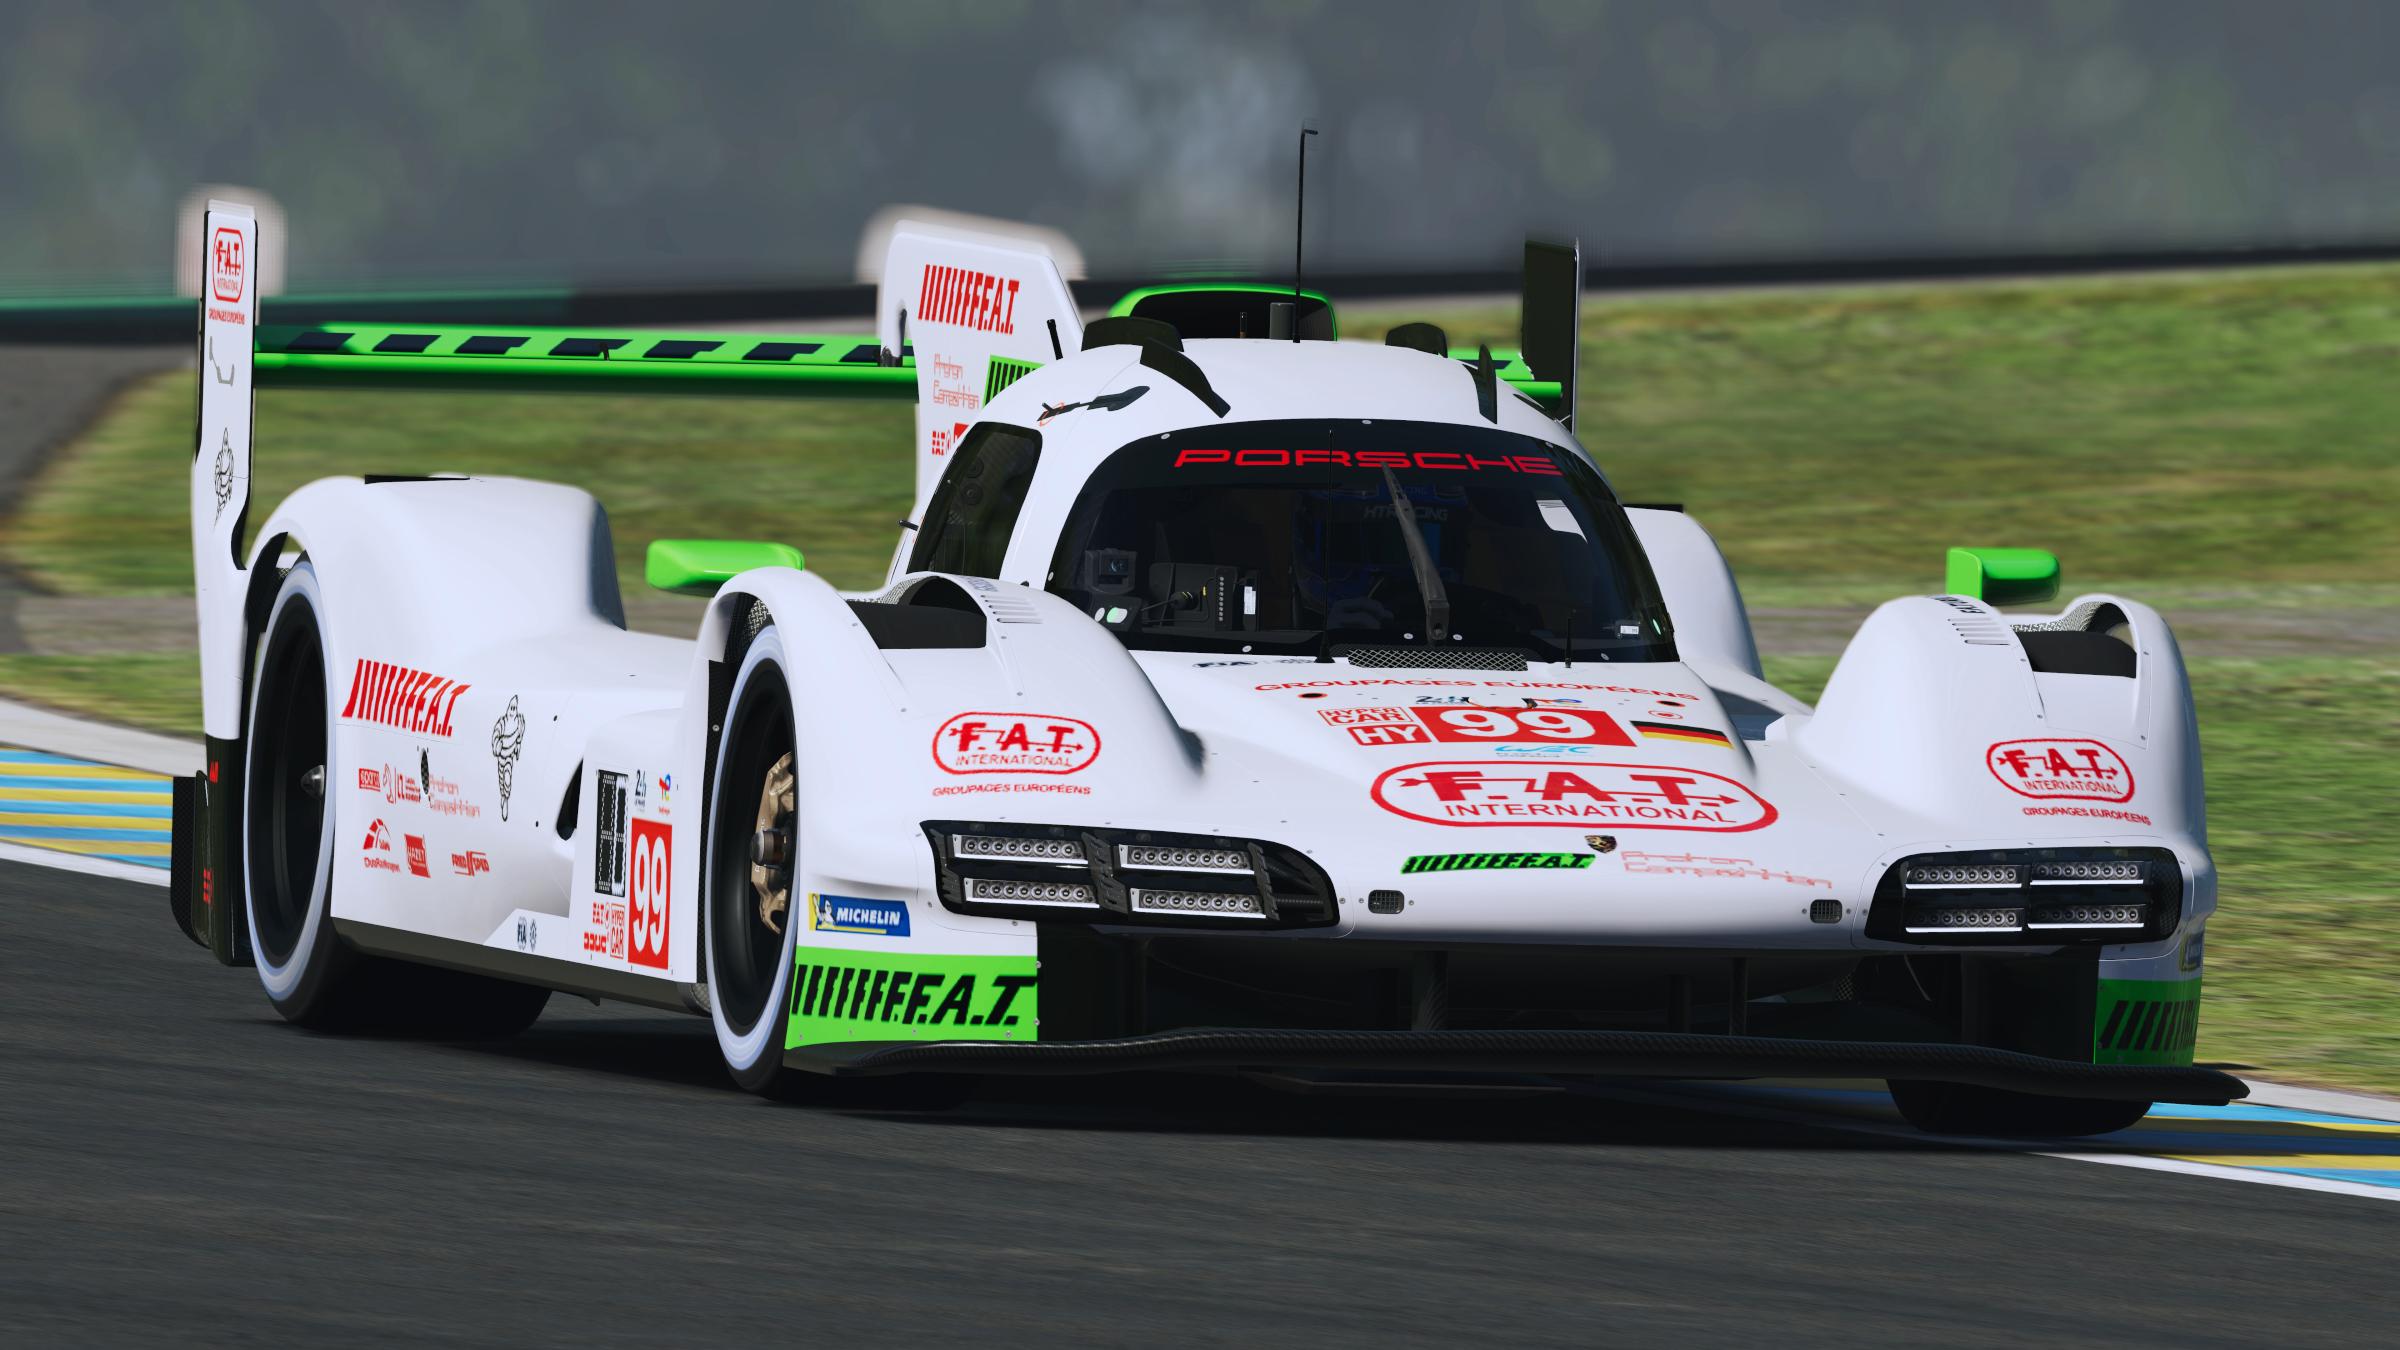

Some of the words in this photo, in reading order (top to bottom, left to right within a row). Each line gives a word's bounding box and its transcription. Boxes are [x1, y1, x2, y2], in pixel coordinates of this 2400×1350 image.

[1174, 449, 1563, 476] PORSCHE
[1254, 678, 1476, 691] GROUPAGES
[1326, 707, 1399, 717] HYPER
[1330, 713, 1406, 724] CAR
[1440, 710, 1596, 739] 99
[1353, 726, 1419, 744] HY
[956, 753, 1073, 767] INTERNATIONAL
[932, 783, 1010, 796] GROUPAGES
[1423, 770, 1722, 807] F.A.T.
[2024, 780, 2123, 795] INTERNATIONAL
[1445, 801, 1737, 824] INTERNATIONAL
[2023, 807, 2088, 817] GROUPAGES
[633, 833, 667, 957] 99
[837, 907, 900, 926] MICHELIN
[611, 926, 624, 955] CAR
